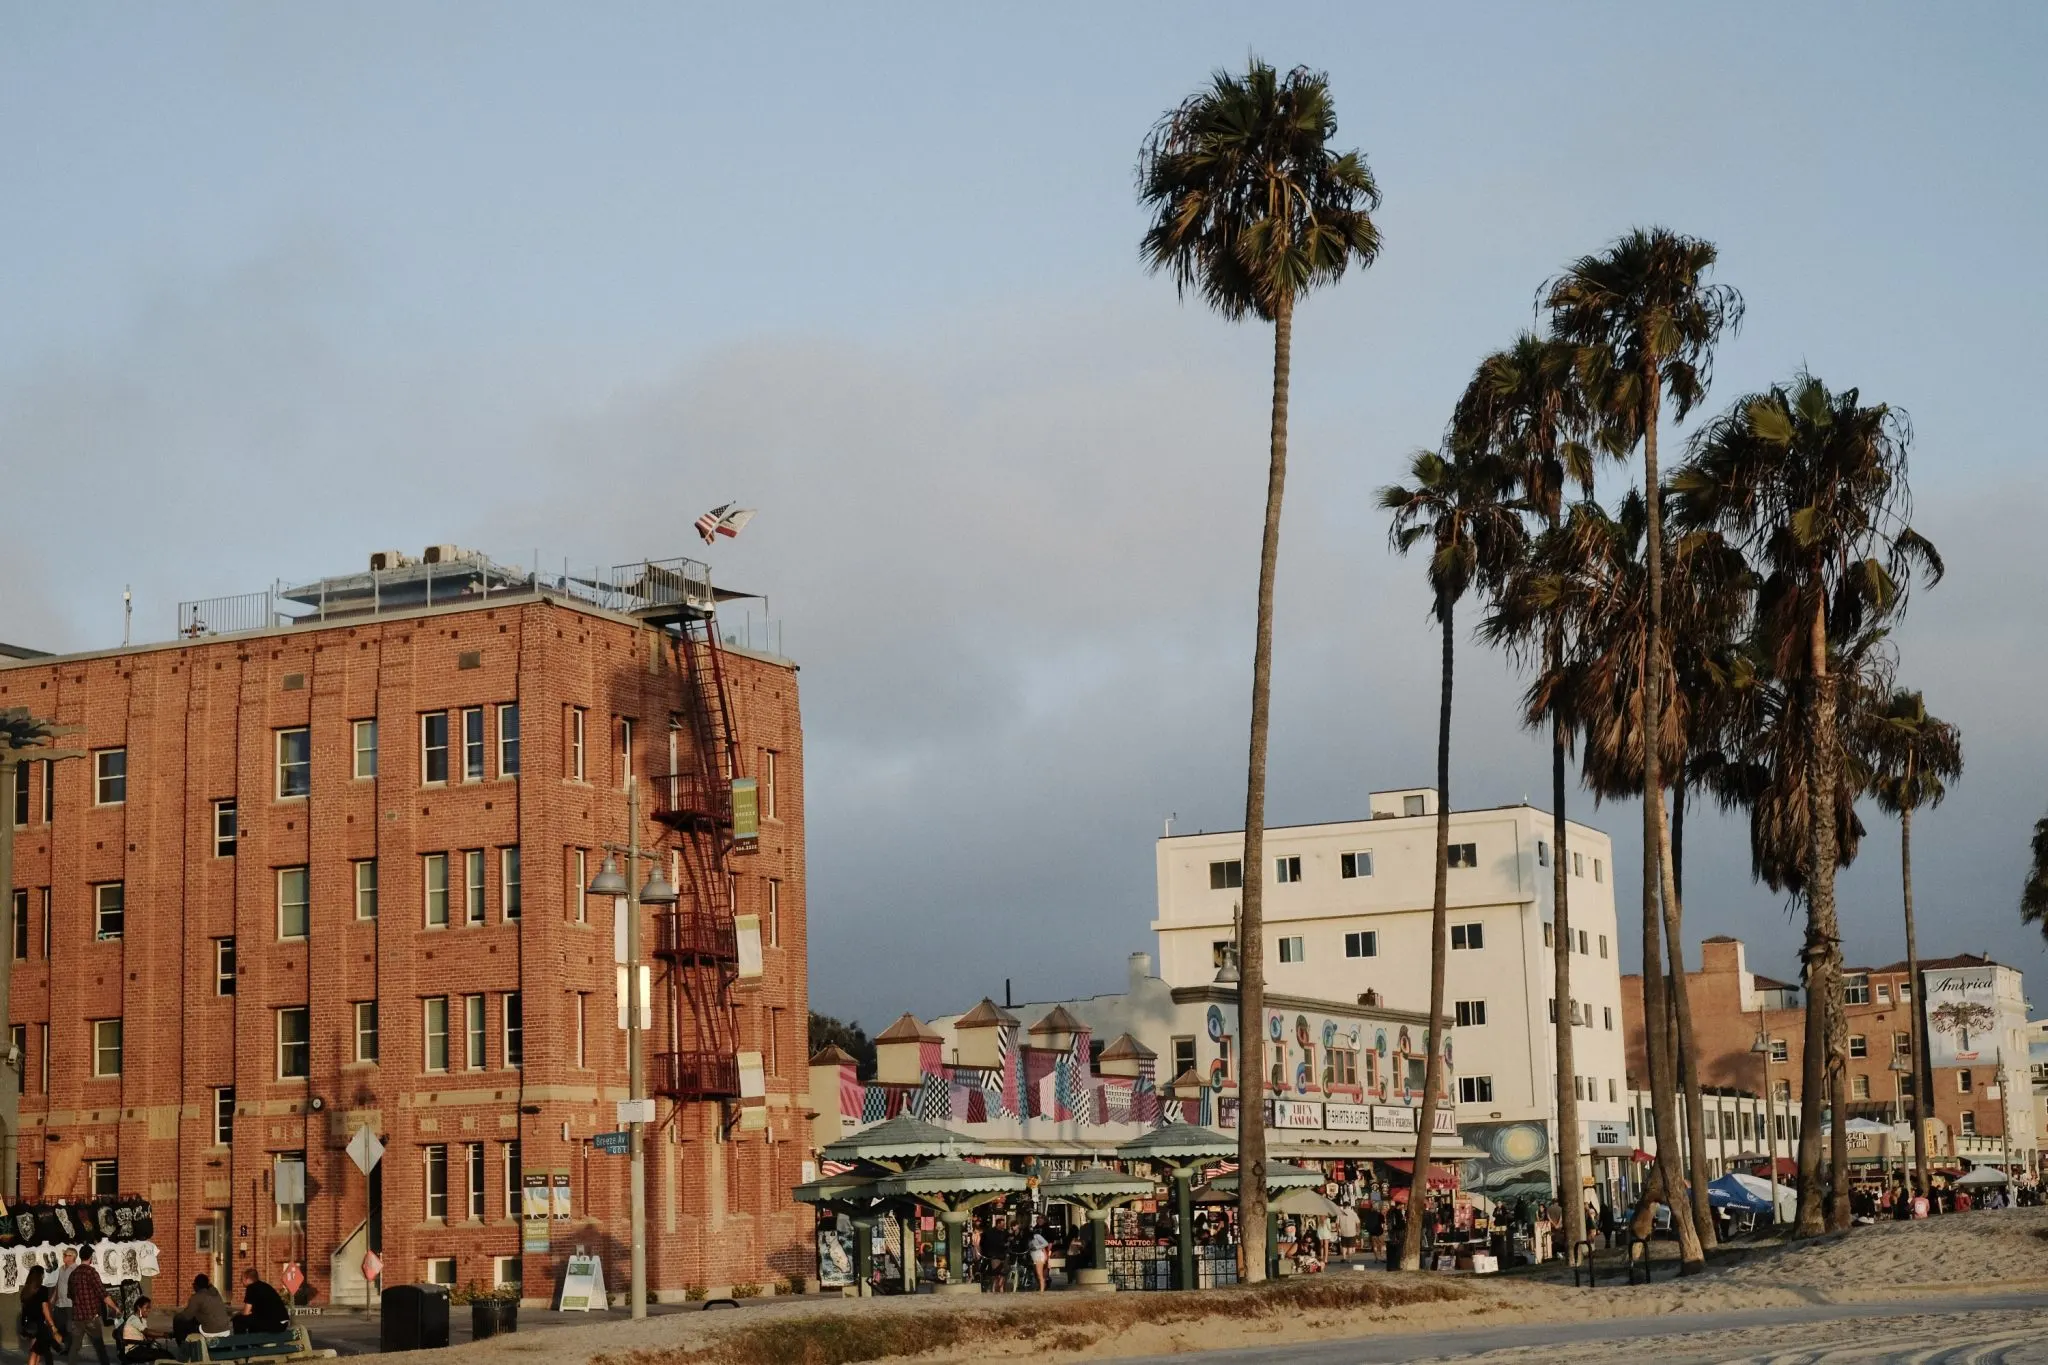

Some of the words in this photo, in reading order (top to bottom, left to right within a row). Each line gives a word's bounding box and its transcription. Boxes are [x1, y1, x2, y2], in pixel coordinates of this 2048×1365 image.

[1930, 977, 1993, 992] America
[1290, 1115, 1319, 1126] FASHION
[1327, 1109, 1349, 1124] T-SHIRTS
[1355, 1110, 1369, 1125] GIFTS
[1436, 1112, 1454, 1130] ZZA
[596, 1136, 616, 1146] Breeze
[618, 1134, 626, 1144] Av
[1597, 1132, 1619, 1144] MARKET
